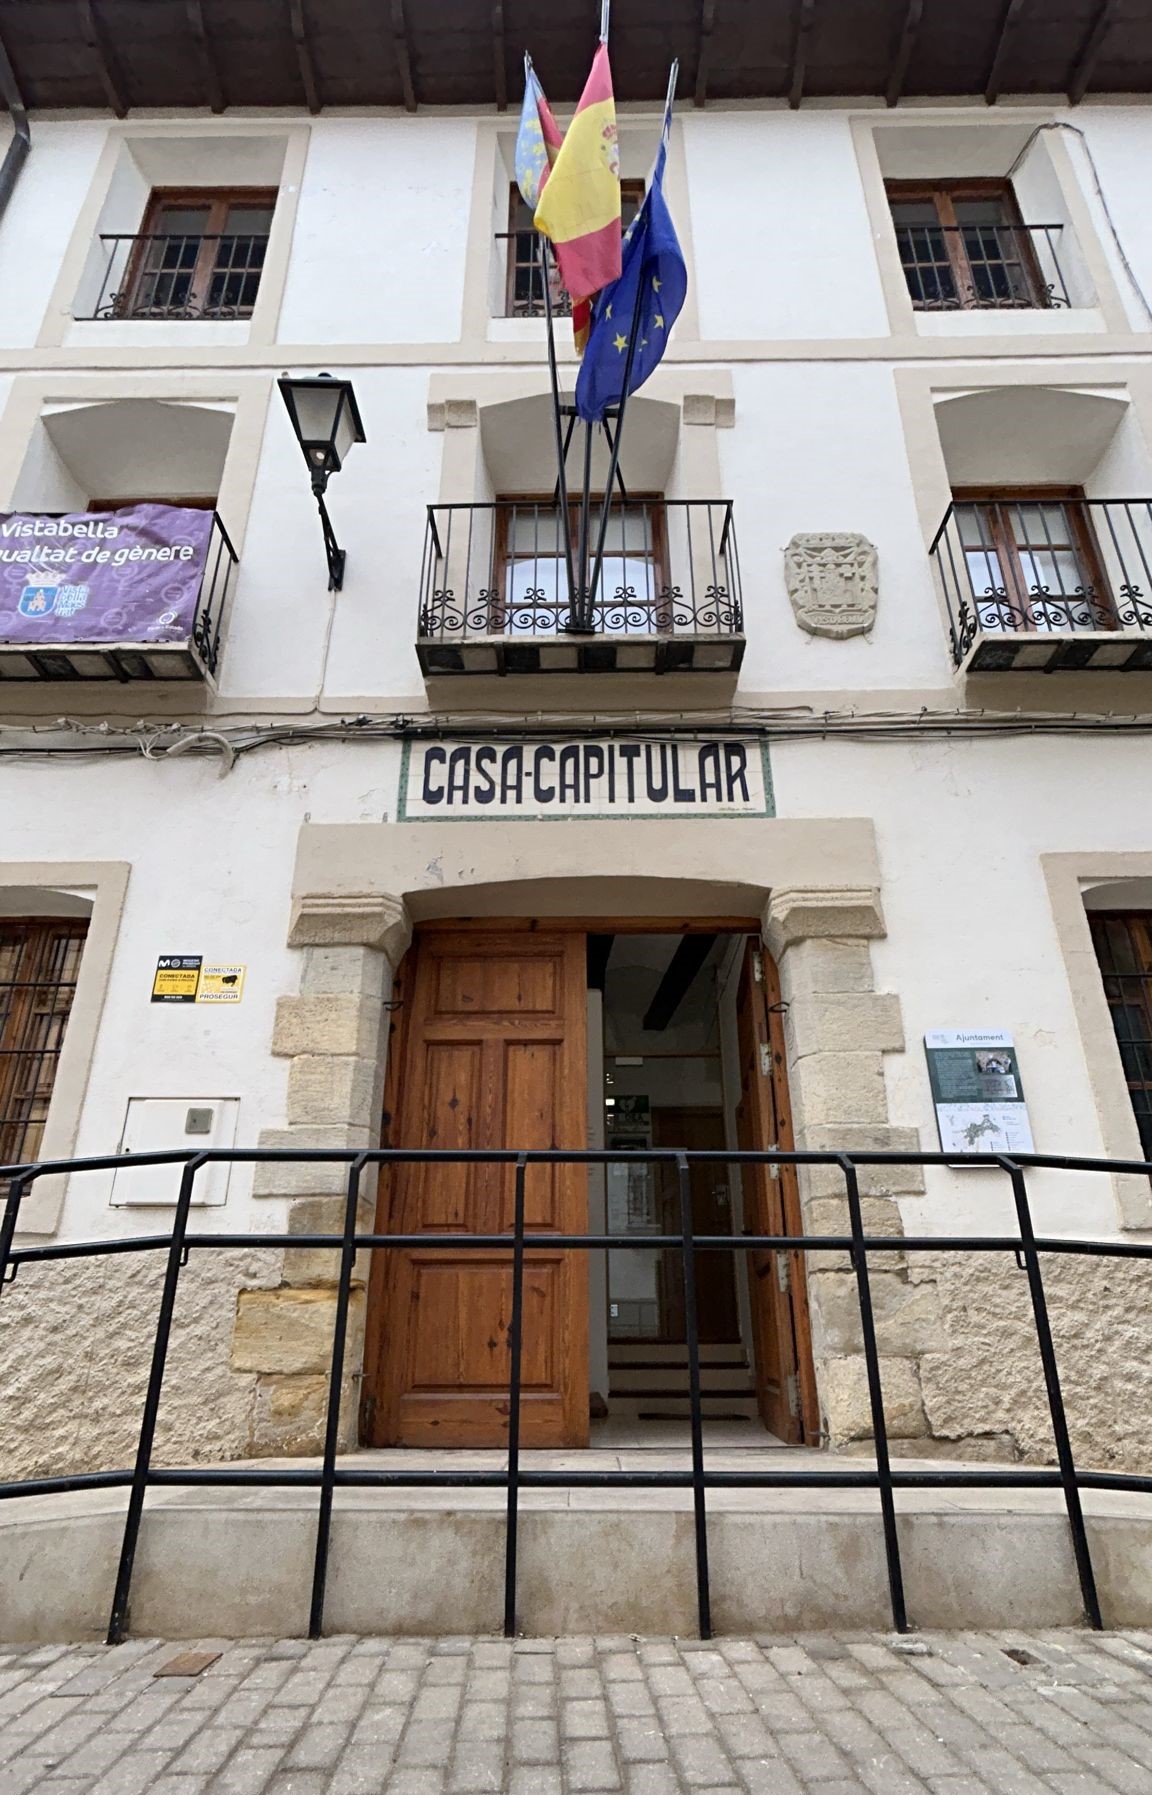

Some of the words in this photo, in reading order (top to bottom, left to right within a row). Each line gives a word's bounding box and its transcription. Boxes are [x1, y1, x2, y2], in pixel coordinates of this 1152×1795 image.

[0, 545, 78, 563] ualtat
[81, 546, 109, 563] de
[111, 545, 194, 566] gènere
[422, 743, 750, 804] CASA-CAPITULAR
[956, 1034, 1004, 1042] Ajuntament
